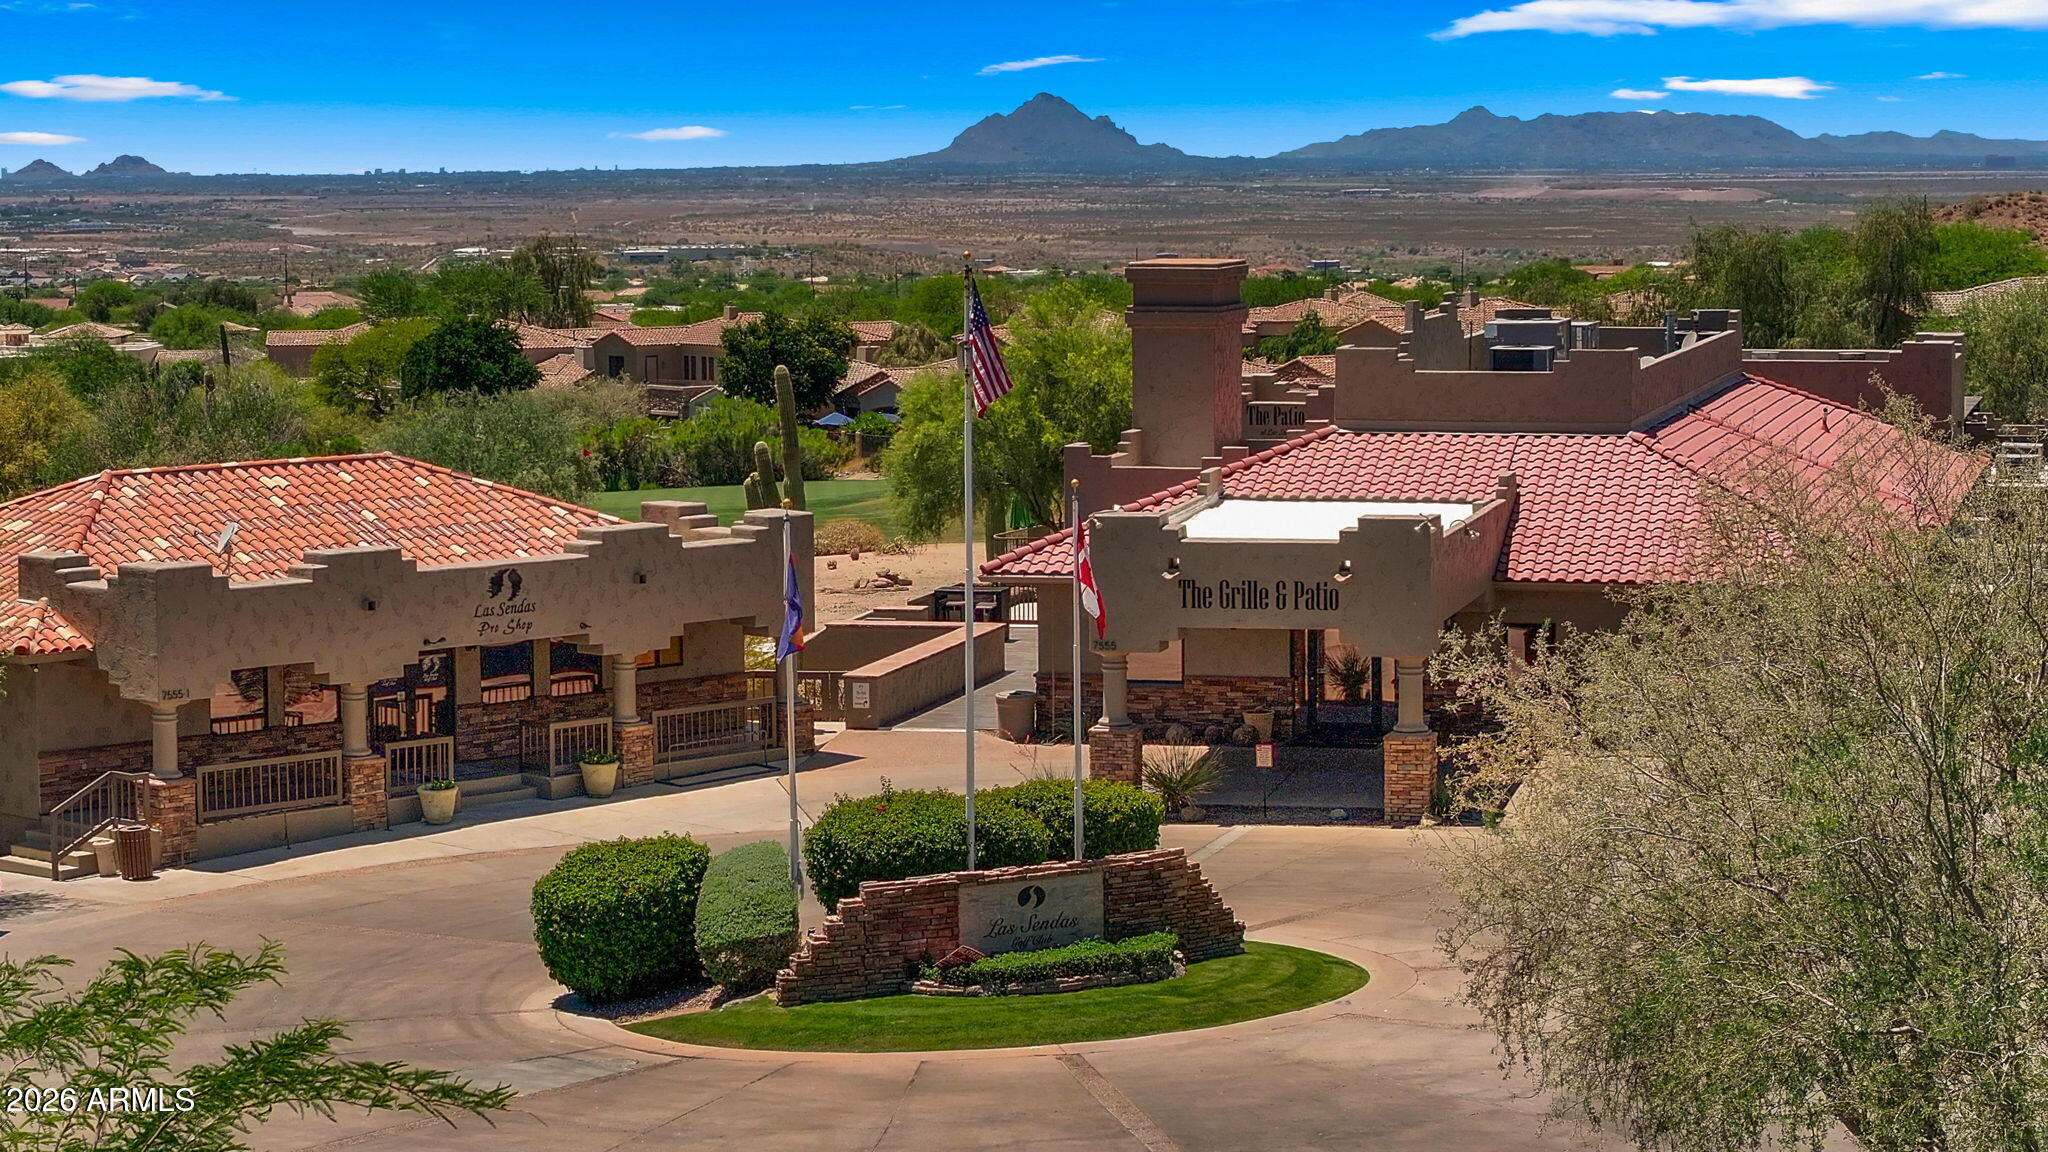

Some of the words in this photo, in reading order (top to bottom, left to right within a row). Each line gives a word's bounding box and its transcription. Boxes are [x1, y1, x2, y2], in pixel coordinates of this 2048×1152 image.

[1247, 405, 1269, 425] The
[1274, 405, 1304, 425] Patio
[1178, 579, 1212, 609] The
[1219, 579, 1269, 610] Grille
[1276, 580, 1286, 610] &
[1293, 580, 1339, 611] Patio
[474, 604, 495, 618] Las
[497, 598, 536, 617] Sendas
[477, 621, 499, 636] Pro
[503, 618, 533, 635] Shop
[1093, 640, 1117, 650] 7555
[983, 917, 1016, 939] Las
[1020, 911, 1080, 934] Sendas
